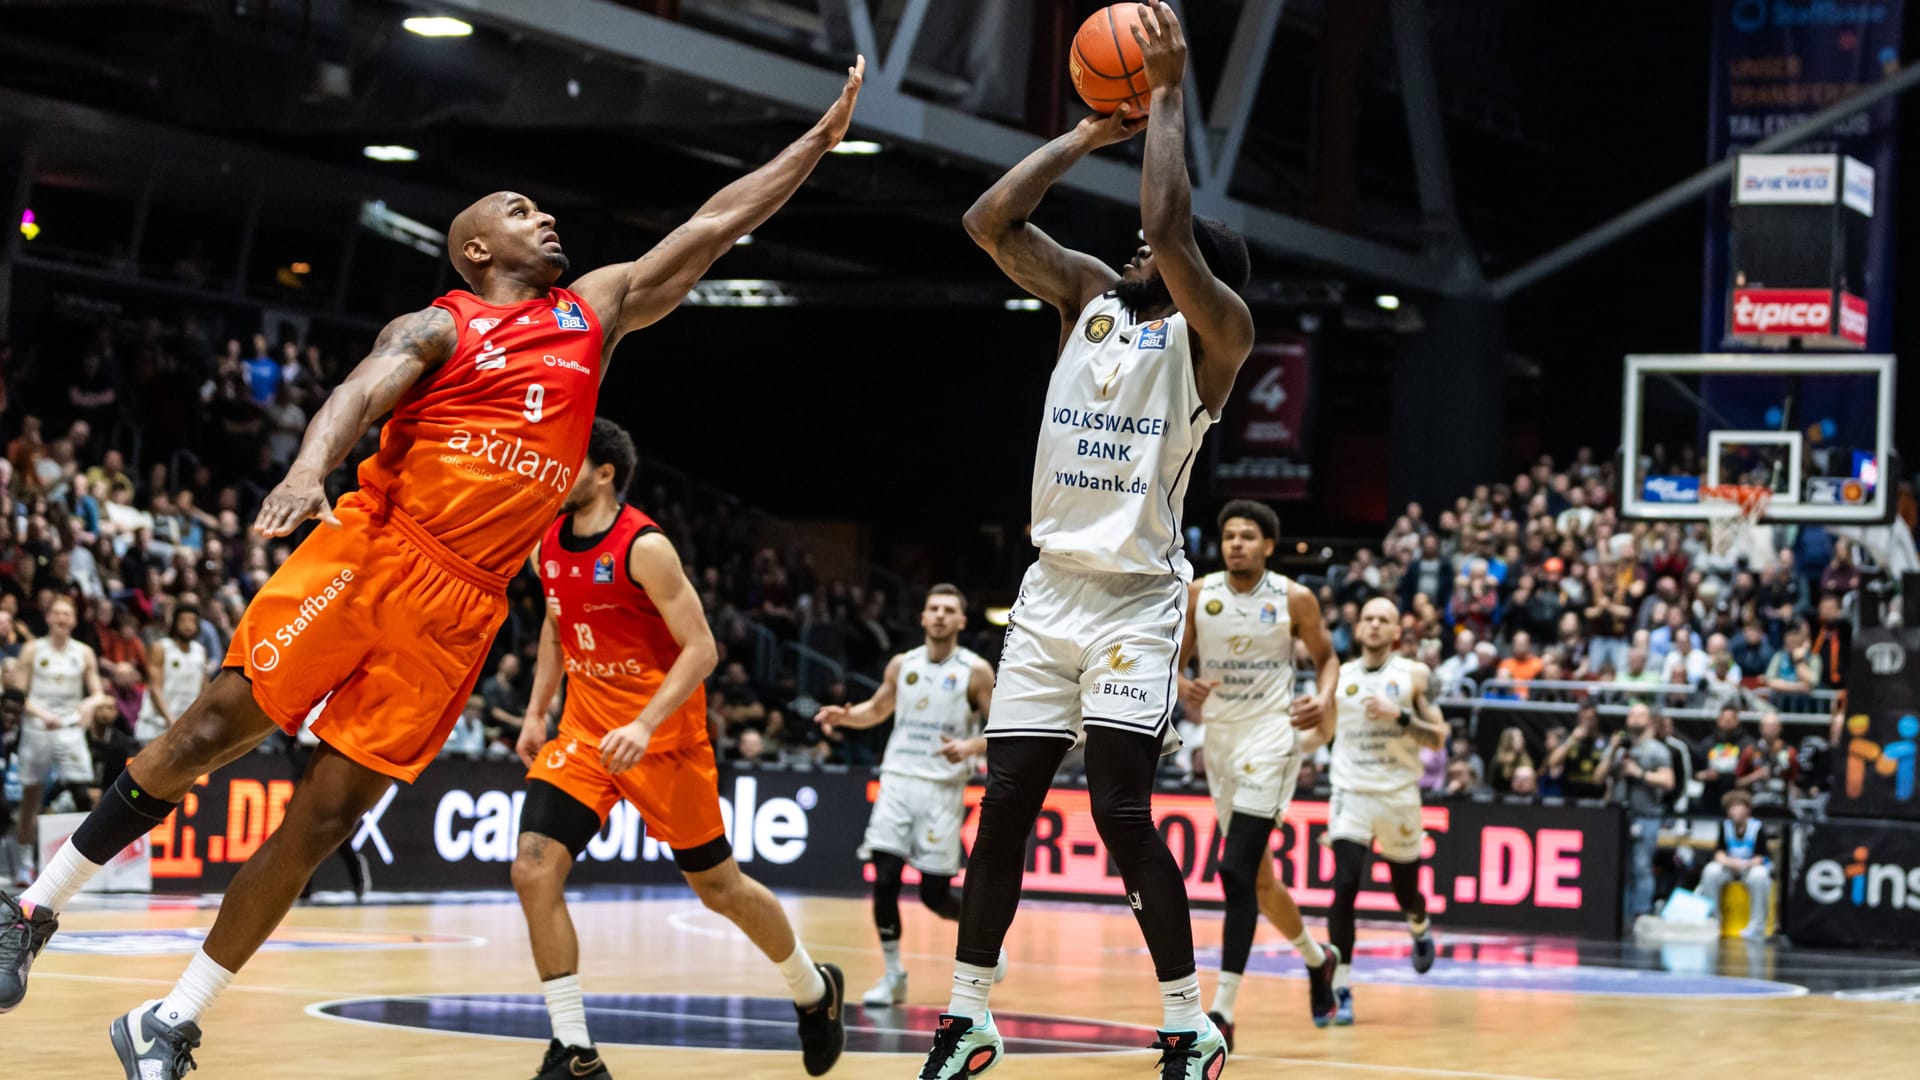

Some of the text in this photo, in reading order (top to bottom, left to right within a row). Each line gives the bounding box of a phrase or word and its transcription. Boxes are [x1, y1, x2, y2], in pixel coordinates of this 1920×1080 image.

[562, 319, 585, 328] BBL
[1734, 297, 1830, 331] tipico
[557, 358, 590, 375] Staffbase
[523, 383, 544, 423] 9
[1249, 367, 1287, 412] 4
[1053, 407, 1170, 438] VOLKSWAGEN
[447, 428, 571, 493] axilaris
[1077, 439, 1132, 462] BANK
[1055, 471, 1147, 495] vwbank.de
[275, 568, 355, 648] Staffbase
[573, 622, 596, 651] 13
[1103, 682, 1148, 703] BLACK
